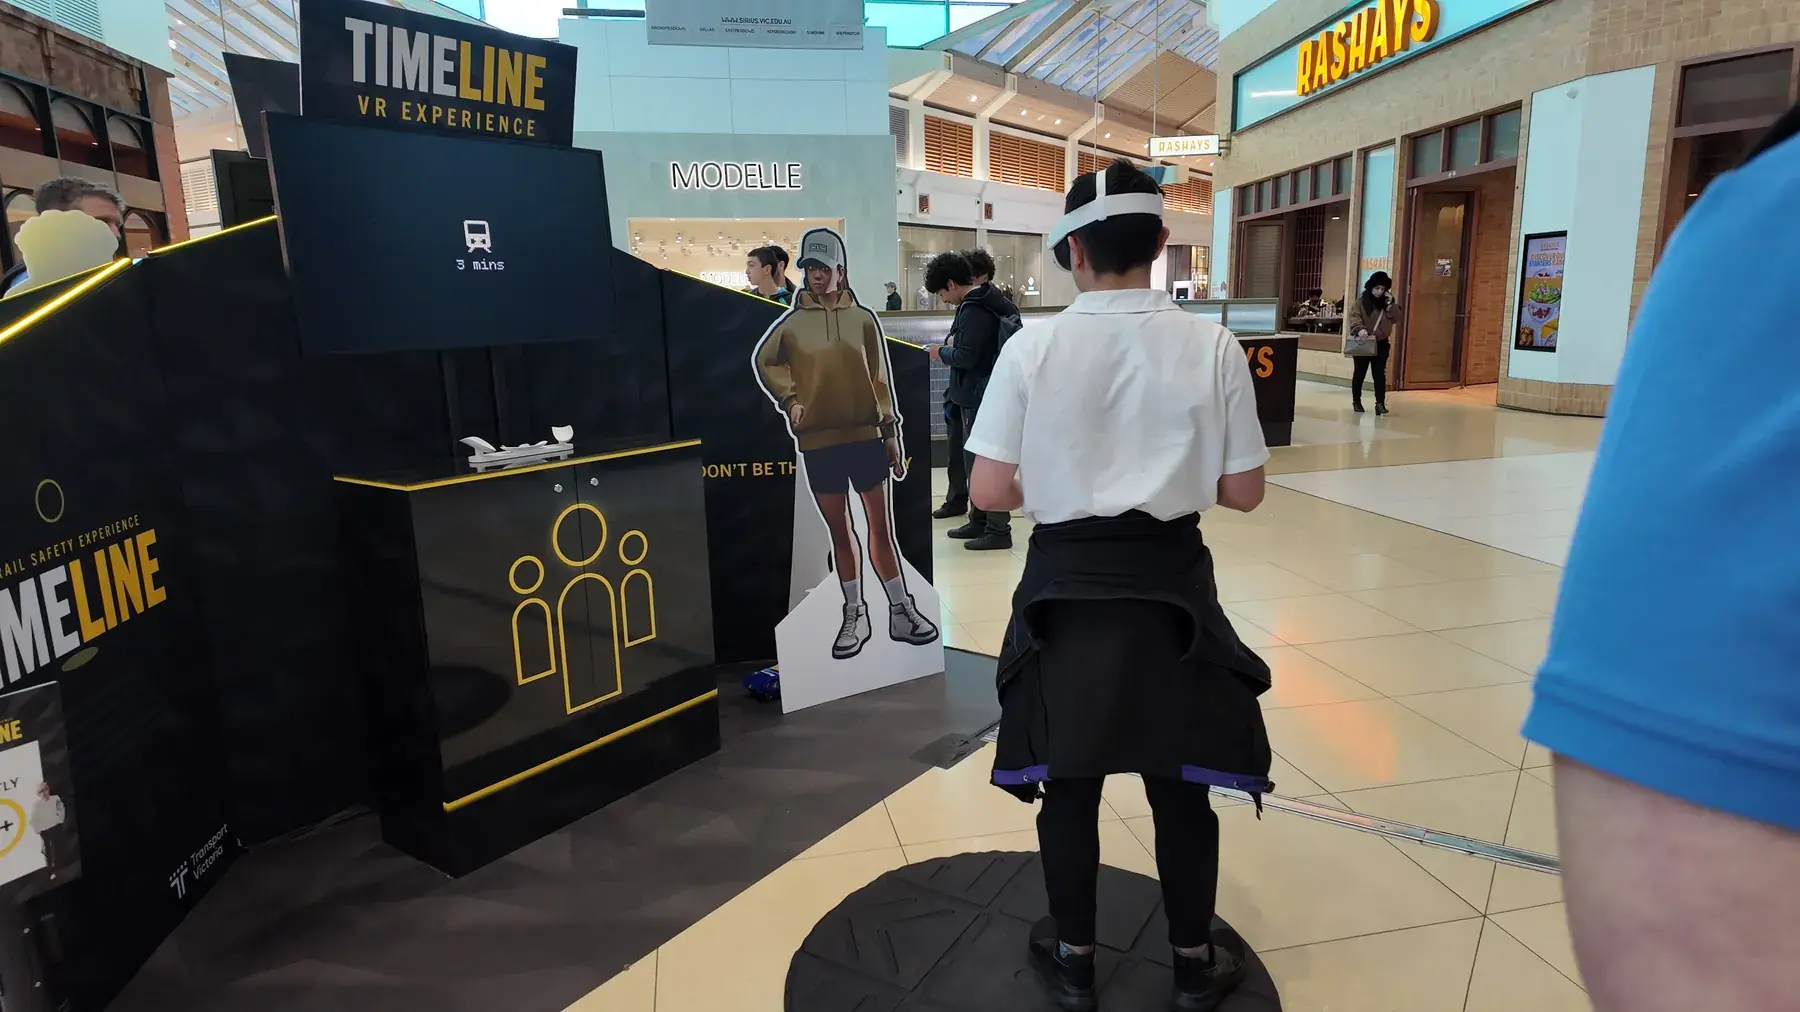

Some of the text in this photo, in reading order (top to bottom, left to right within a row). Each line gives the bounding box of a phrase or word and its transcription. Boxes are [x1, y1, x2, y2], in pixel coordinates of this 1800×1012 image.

[345, 17, 547, 111] TIMELINE
[1297, 0, 1437, 96] RASHAYS
[357, 94, 536, 137] VR EXPERIENCE
[1159, 140, 1211, 153] RASHAYS
[671, 162, 802, 189] MODELLE
[456, 258, 505, 270] 3 mins
[752, 462, 774, 476] BE
[30, 539, 74, 566] SAFETY
[78, 514, 141, 548] EXPERIENCE
[0, 528, 167, 689] MELINE
[190, 823, 228, 866] Transport
[193, 845, 223, 880] Victoria
